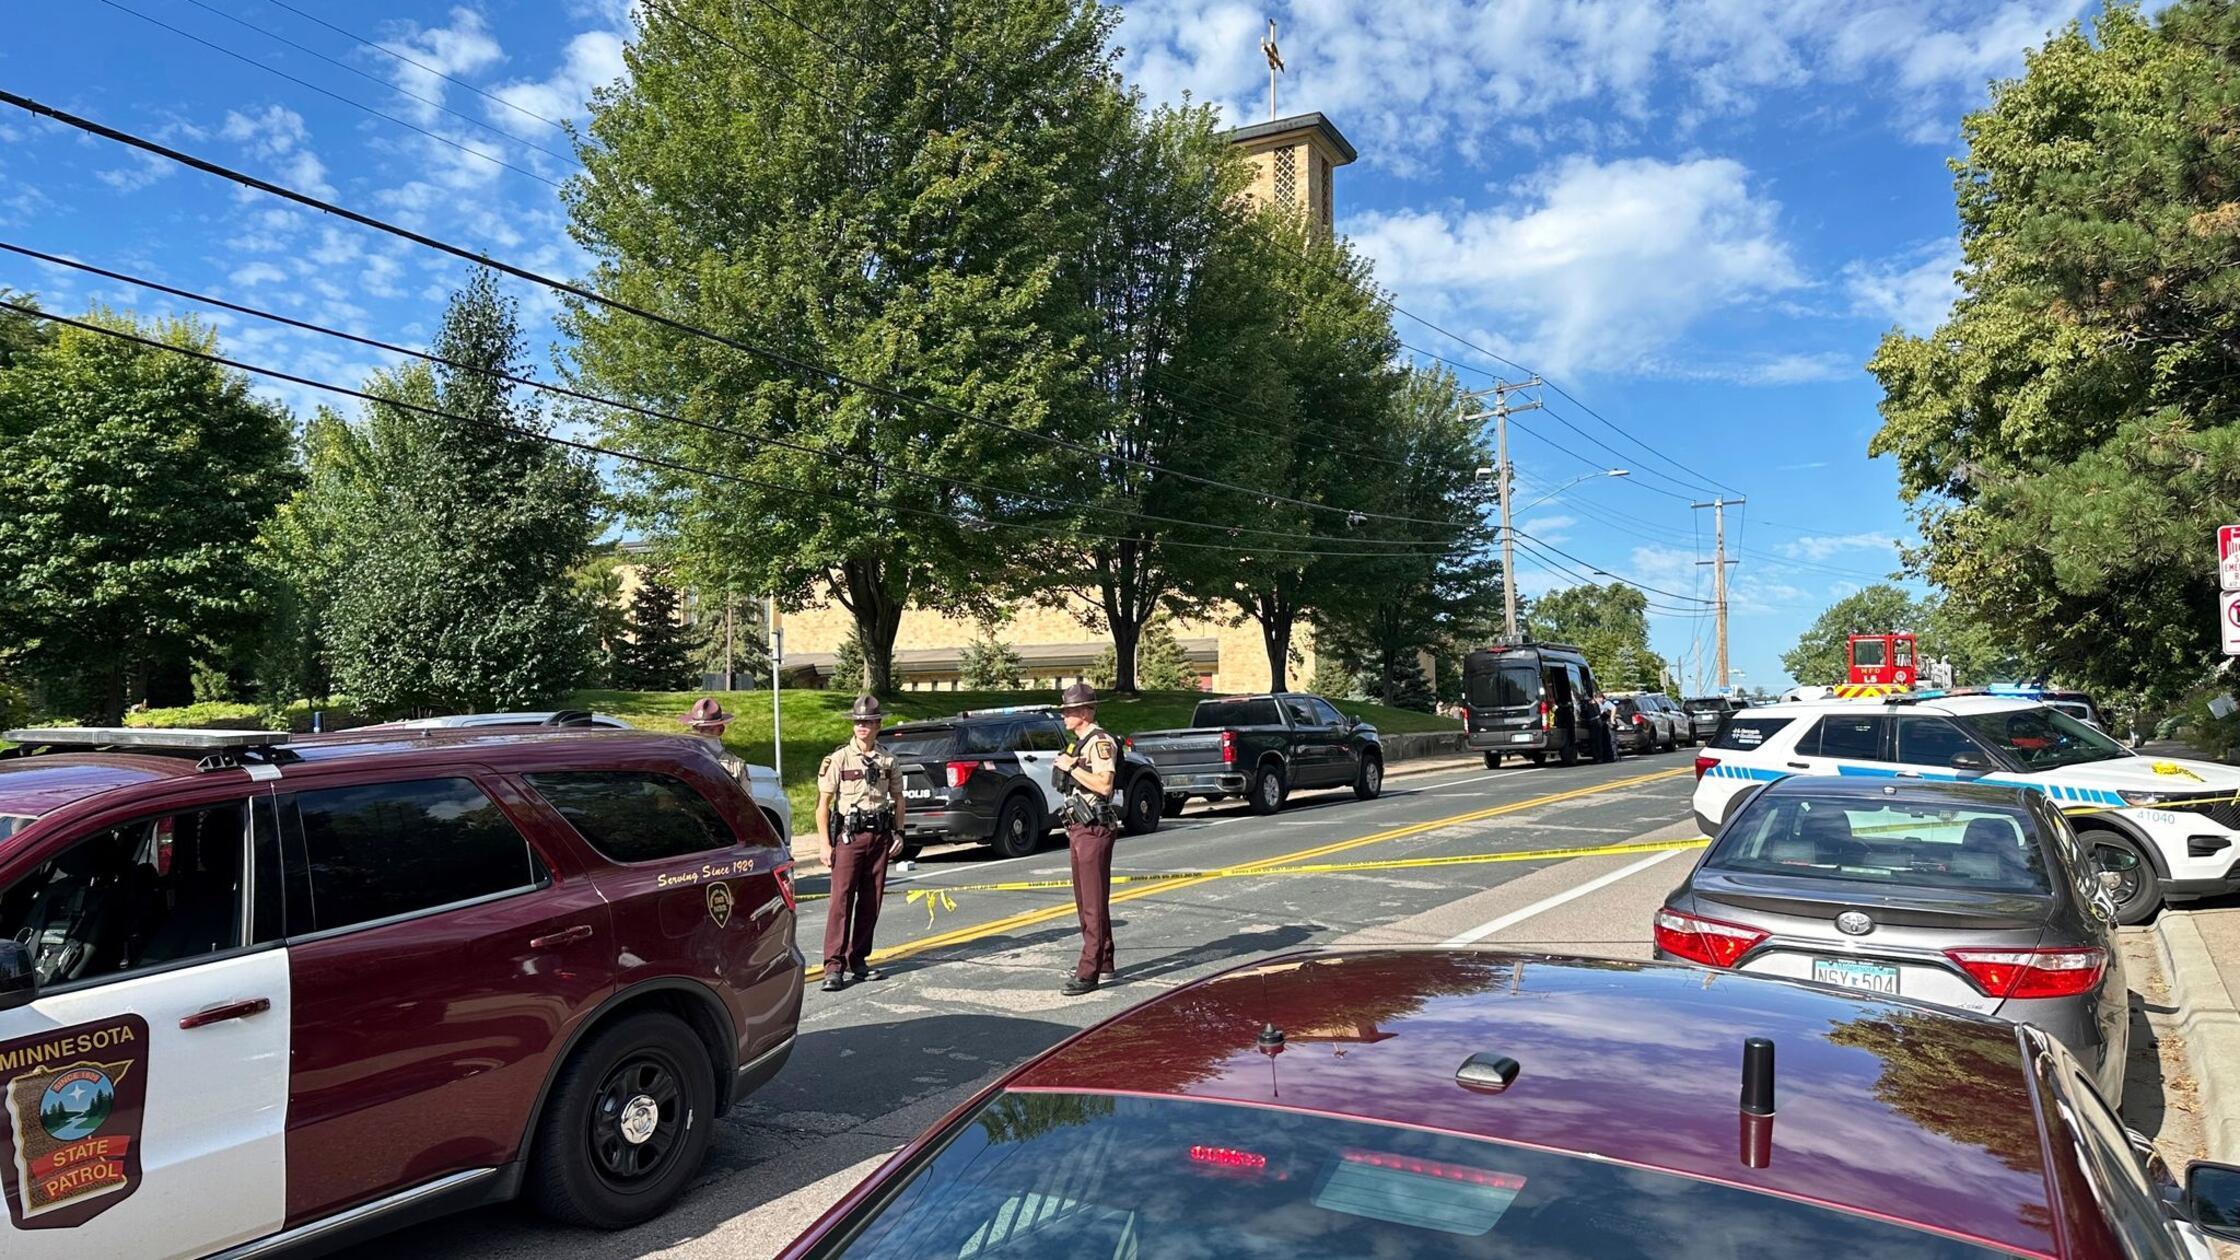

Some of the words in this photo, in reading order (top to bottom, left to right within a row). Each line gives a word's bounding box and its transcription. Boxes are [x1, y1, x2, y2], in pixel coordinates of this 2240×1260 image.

[2137, 810, 2175, 825] 41040
[657, 873, 699, 887] Serving
[702, 864, 730, 878] Since
[733, 859, 754, 873] 1929
[1862, 973, 1894, 993] 504
[0, 1025, 135, 1071] MINNESOTA
[53, 1139, 109, 1168] STATE
[46, 1163, 119, 1197] PATROL
